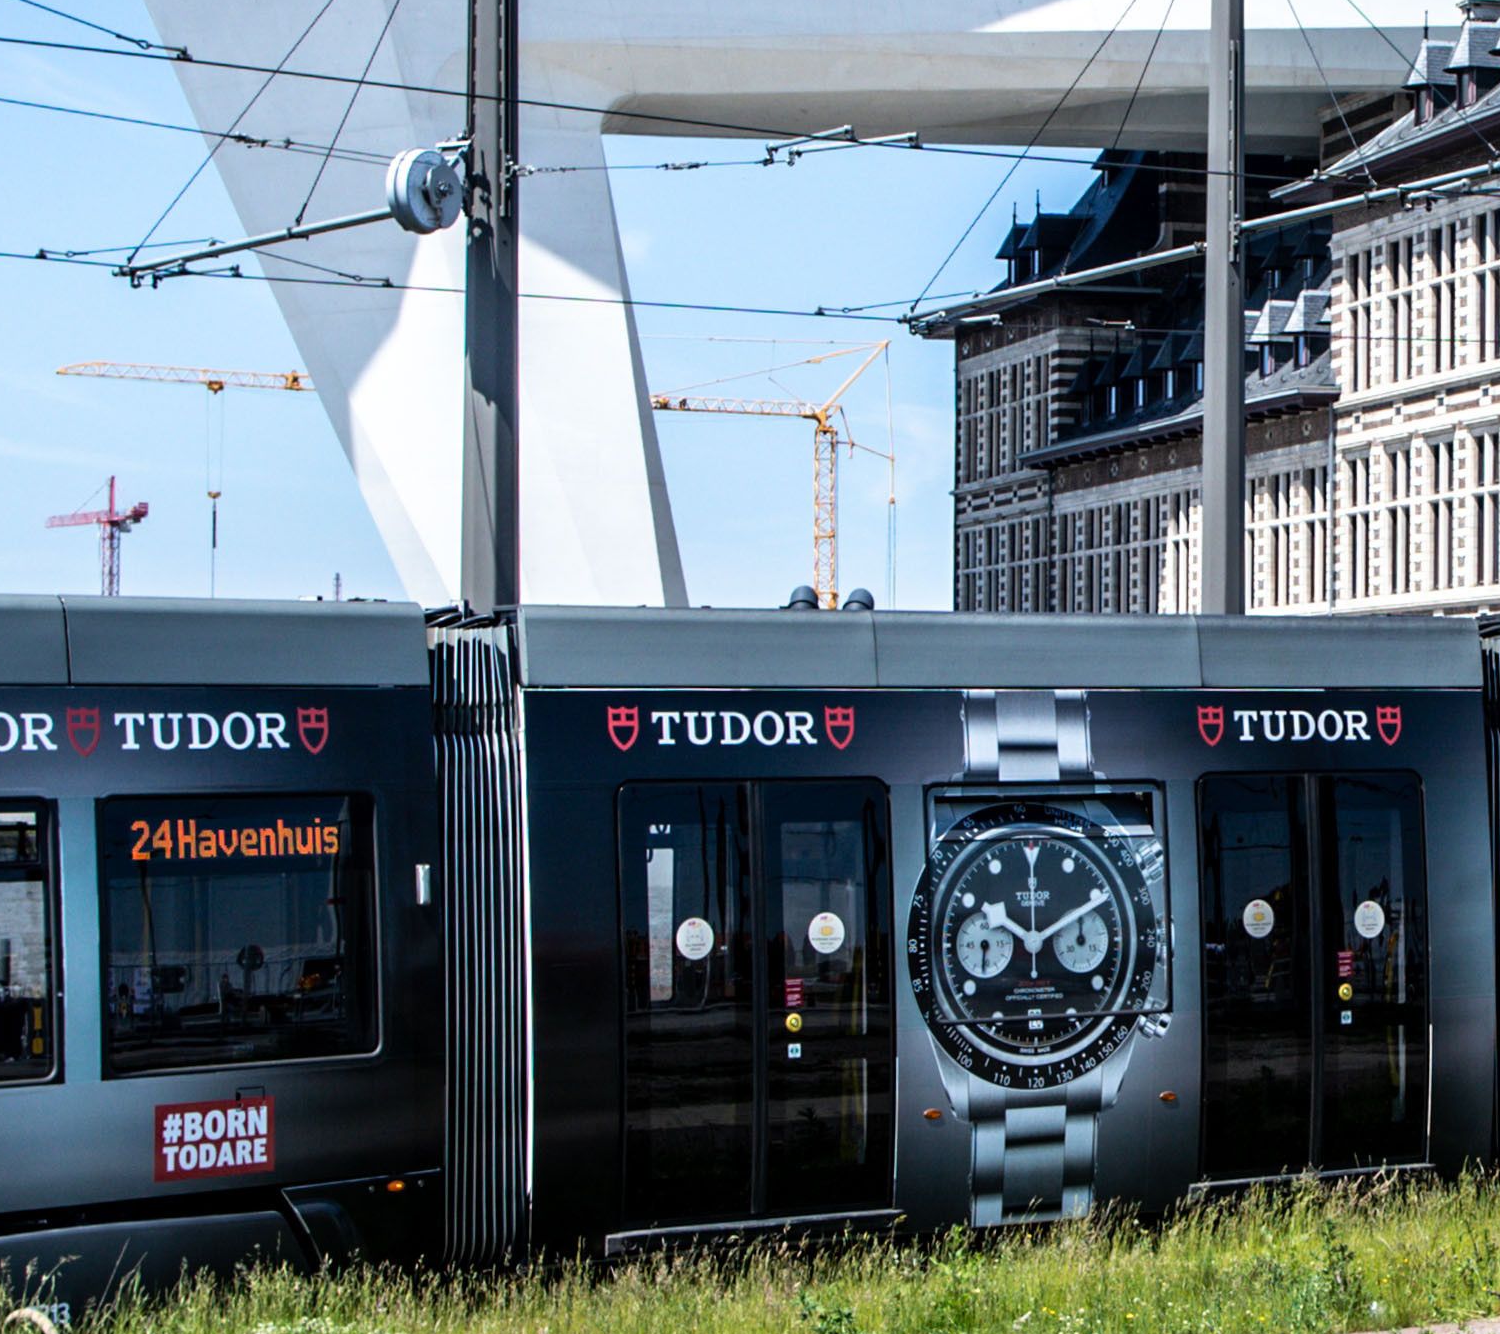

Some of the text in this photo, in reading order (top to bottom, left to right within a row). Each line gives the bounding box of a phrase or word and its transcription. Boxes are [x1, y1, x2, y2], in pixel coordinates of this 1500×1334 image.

[113, 711, 290, 750] TUDOR
[651, 710, 818, 746] TUDOR
[1233, 709, 1372, 742] TUDOR
[130, 817, 340, 861] 24 Havenhuis
[932, 850, 943, 864] 70
[913, 894, 924, 908] 75
[1139, 886, 1150, 906] 300
[908, 938, 918, 954] 80
[996, 940, 1005, 948] 15
[1146, 928, 1156, 949] 240
[912, 978, 923, 993] 85
[1141, 970, 1152, 992] 200
[1113, 1025, 1129, 1044] 160
[956, 1051, 973, 1068] 100
[1098, 1042, 1114, 1060] 150
[1080, 1056, 1097, 1073] 140
[993, 1072, 1011, 1086] 110
[1027, 1076, 1046, 1088] 120
[1056, 1069, 1074, 1084] 130
[162, 1105, 268, 1144] #BORN
[163, 1136, 268, 1172] TODARE
